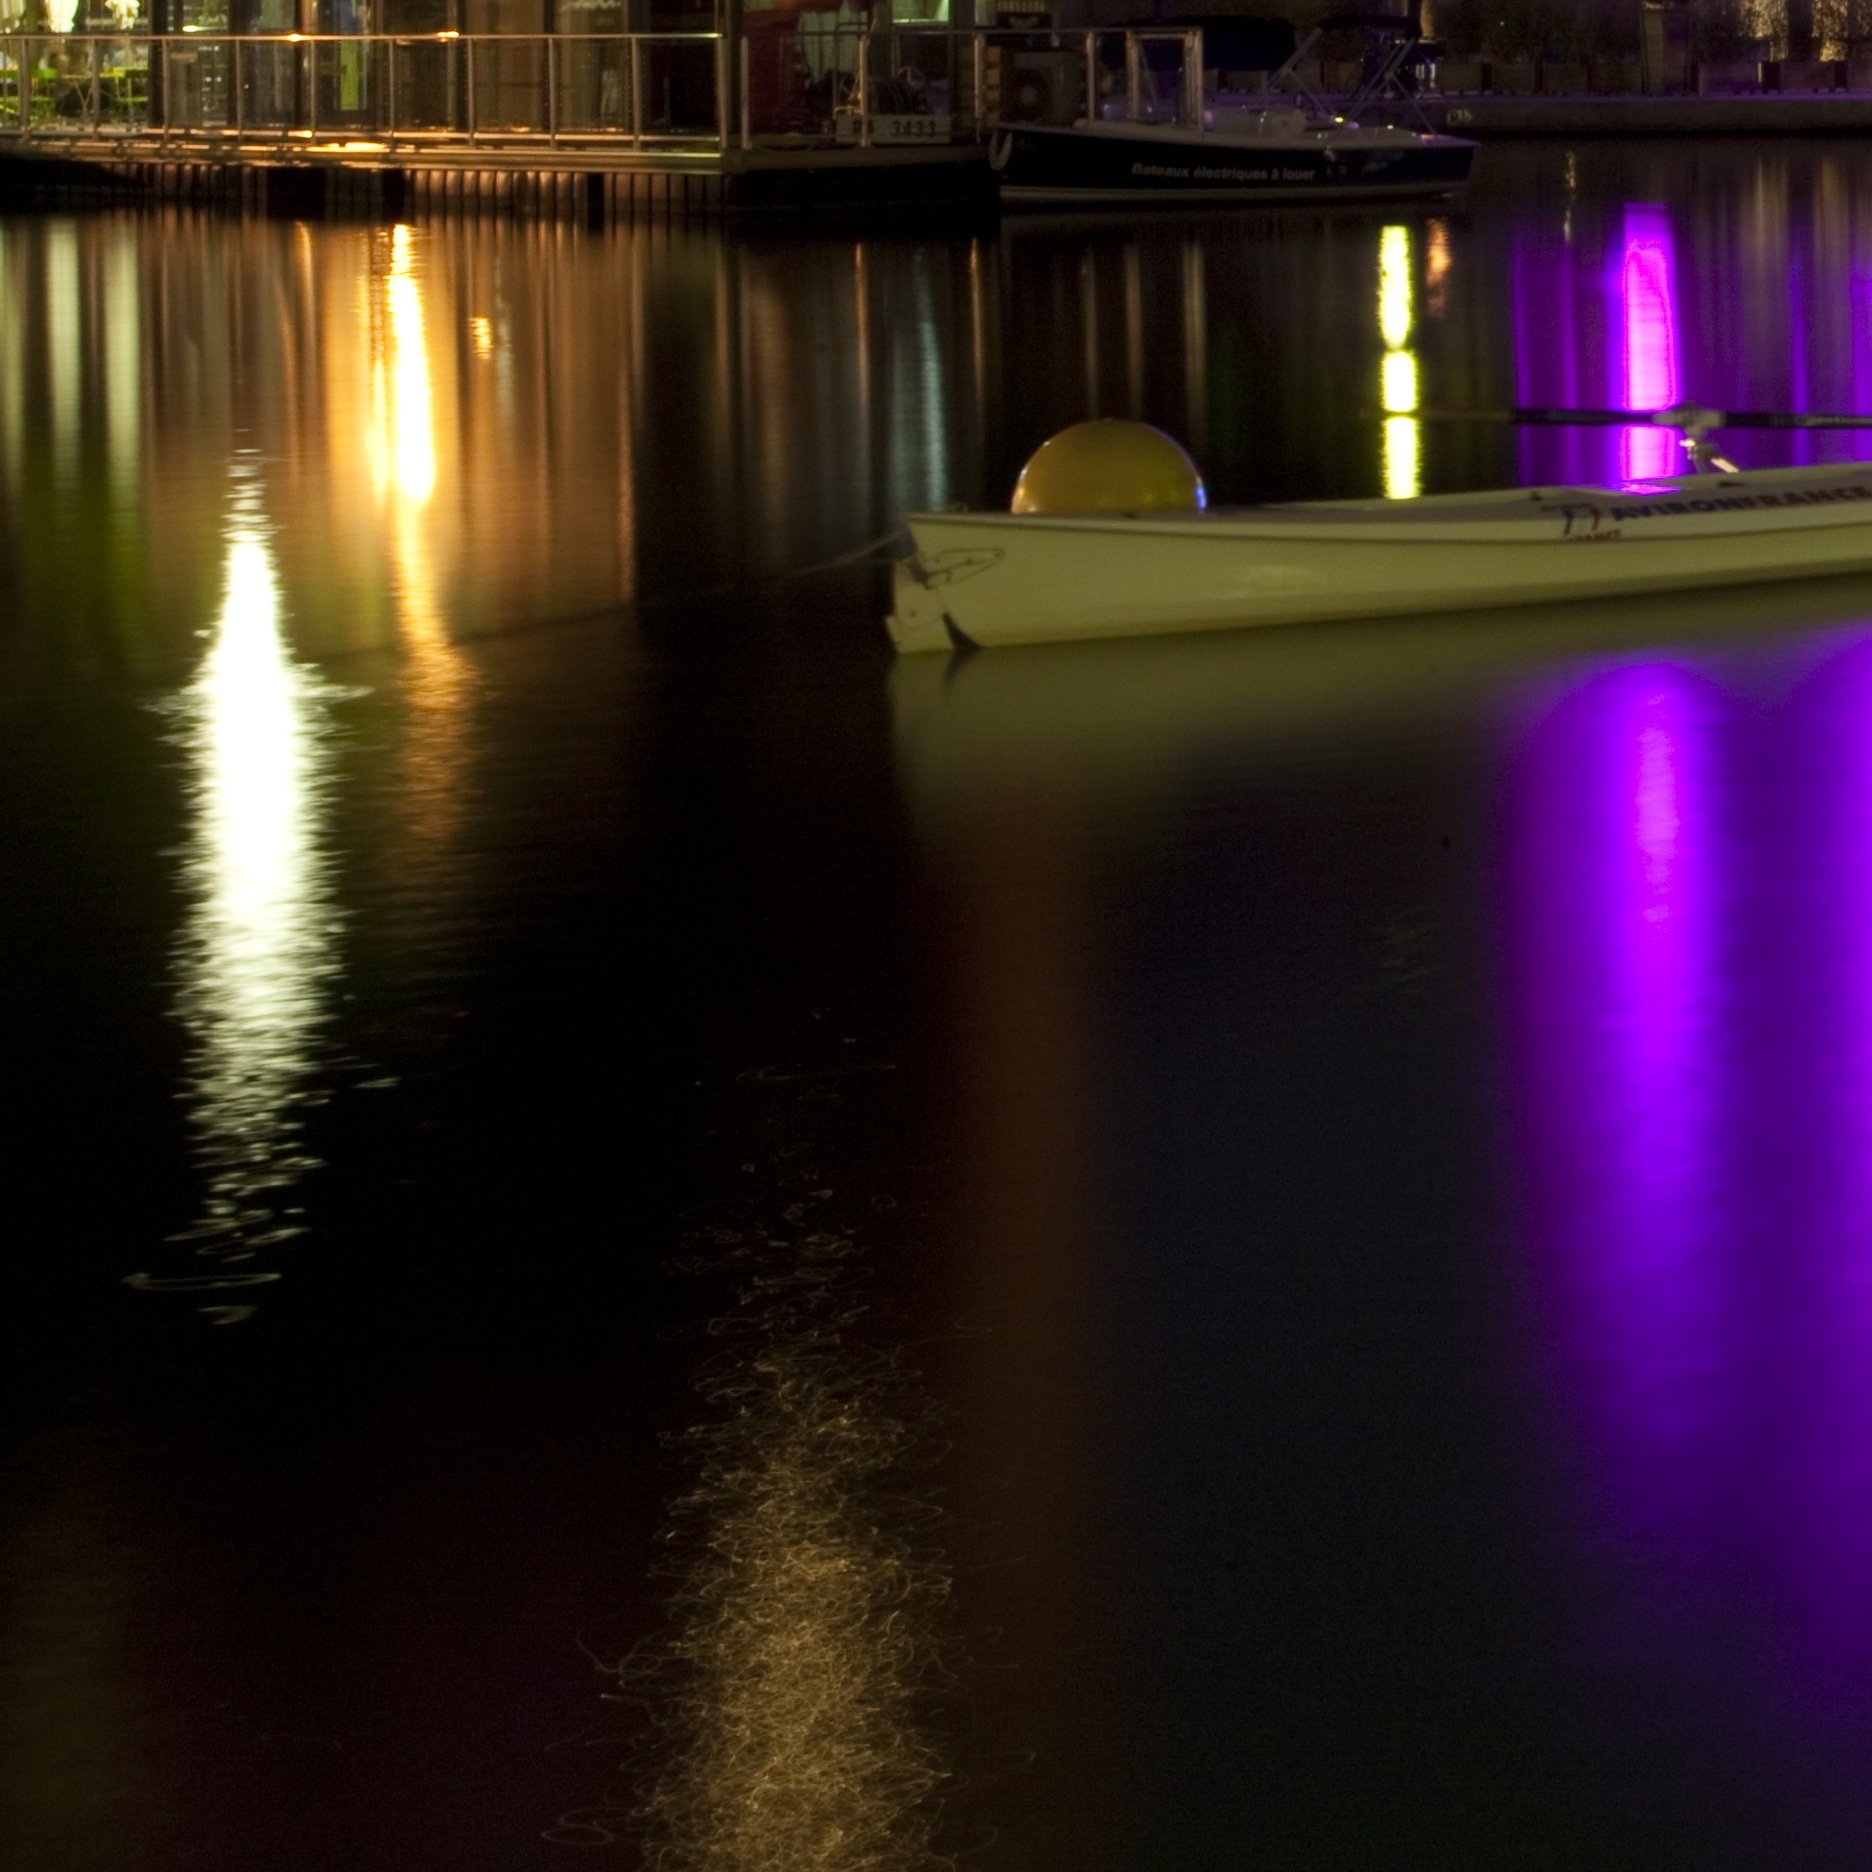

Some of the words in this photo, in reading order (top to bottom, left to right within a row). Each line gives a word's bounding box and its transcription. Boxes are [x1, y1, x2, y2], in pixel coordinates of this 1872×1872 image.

[1131, 162, 1190, 178] Bateaux
[1193, 165, 1268, 182] électriques
[1271, 166, 1280, 181] à
[1282, 167, 1316, 181] louer
